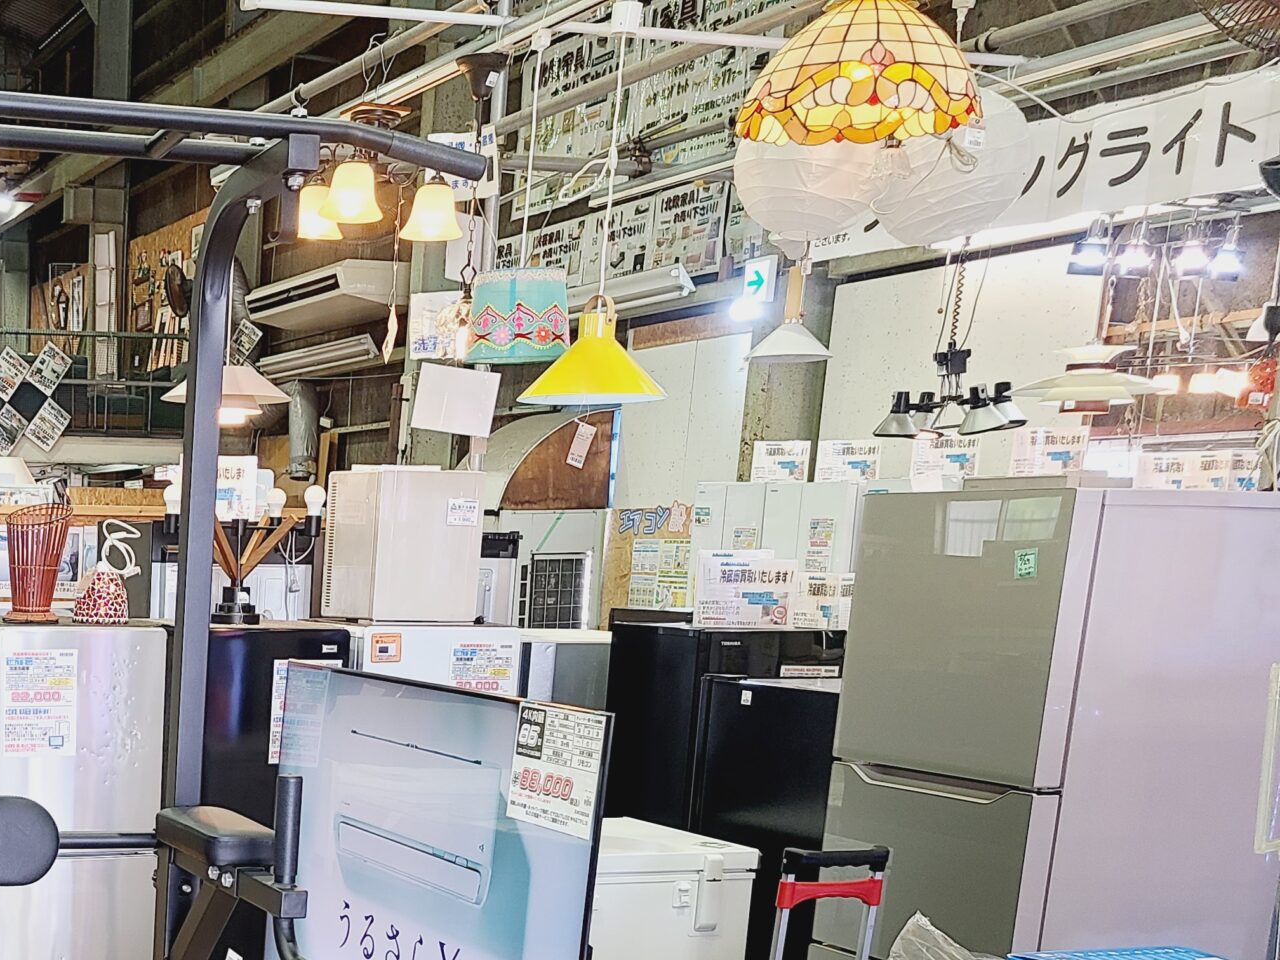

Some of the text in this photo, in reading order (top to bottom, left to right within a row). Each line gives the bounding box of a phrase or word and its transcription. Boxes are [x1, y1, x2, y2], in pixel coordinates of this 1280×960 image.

[619, 500, 694, 536] エアコン設
